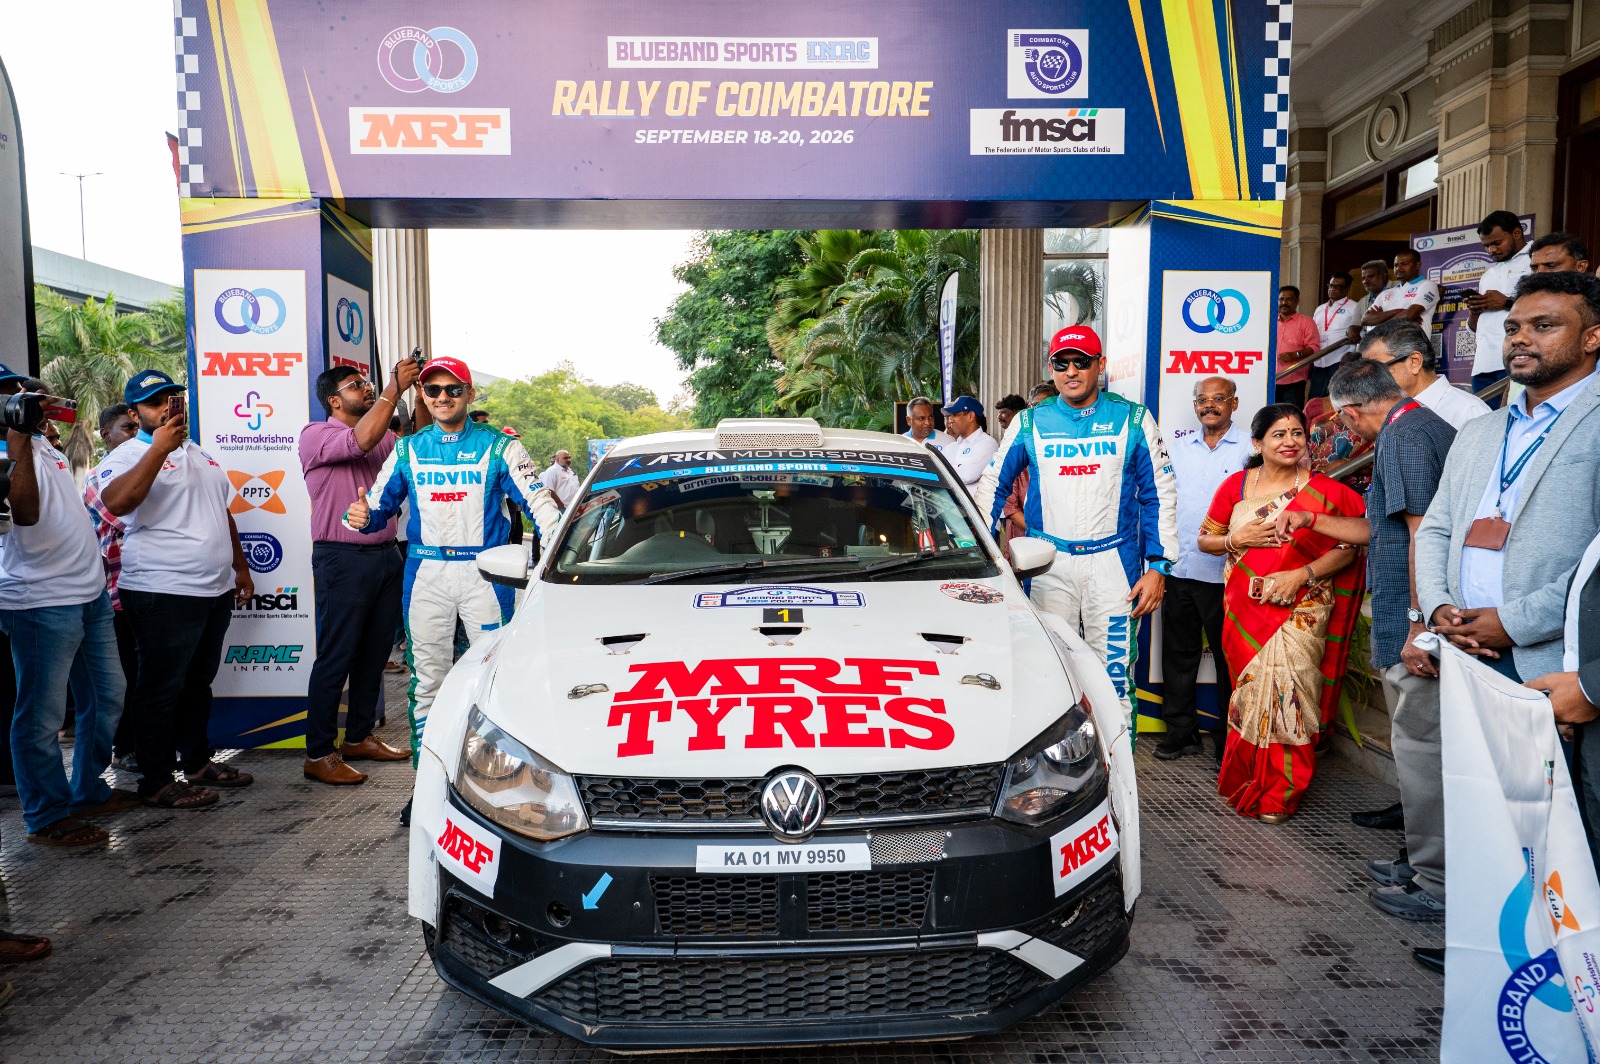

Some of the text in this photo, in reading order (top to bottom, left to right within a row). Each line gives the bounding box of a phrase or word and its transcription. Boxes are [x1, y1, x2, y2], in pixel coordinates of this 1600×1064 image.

[384, 29, 434, 49] BLUEBAND
[1029, 37, 1070, 47] COIMBATORE
[616, 41, 870, 62] BLUEBAND SPORTS INRC
[427, 77, 466, 92] SPORTS
[1029, 71, 1077, 91] AUTO SPORTS CLUB
[552, 80, 934, 117] RALLY OF COIMBATORE
[360, 113, 501, 148] MRF
[1000, 109, 1098, 142] fmsci
[635, 129, 854, 146] SEPTEMBER 18-20, 2026
[218, 289, 255, 303] BLUEBAND
[1187, 289, 1222, 304] BLUEBAND
[250, 324, 279, 334] SPORTS
[1215, 323, 1242, 333] SPORTS
[1059, 333, 1086, 343] MRF
[202, 352, 302, 376] MRF
[1109, 352, 1140, 382] MRF
[1166, 351, 1262, 374] MRF
[1092, 422, 1114, 431] tsi
[1174, 429, 1187, 438] Sri
[216, 434, 294, 443] Sri Ramakrishna
[457, 451, 477, 459] tsi
[1044, 441, 1116, 458] SIDVIN
[647, 450, 925, 467] ARKA MOTORSPORTS
[705, 463, 828, 474] BLUEBAND SPORTS
[1059, 464, 1101, 476] MRF
[416, 471, 482, 485] SIDVIN
[243, 487, 271, 498] PPTS
[430, 492, 467, 502] MRF
[231, 588, 298, 610] msci
[778, 609, 789, 622] 1
[224, 645, 303, 663] RAMC
[613, 657, 939, 702] MRF
[607, 696, 955, 758] TYRES
[438, 817, 494, 874] MRF
[1060, 814, 1111, 879] MRF
[724, 849, 846, 866] KA 01 MV 9950
[1547, 889, 1562, 918] PPTS
